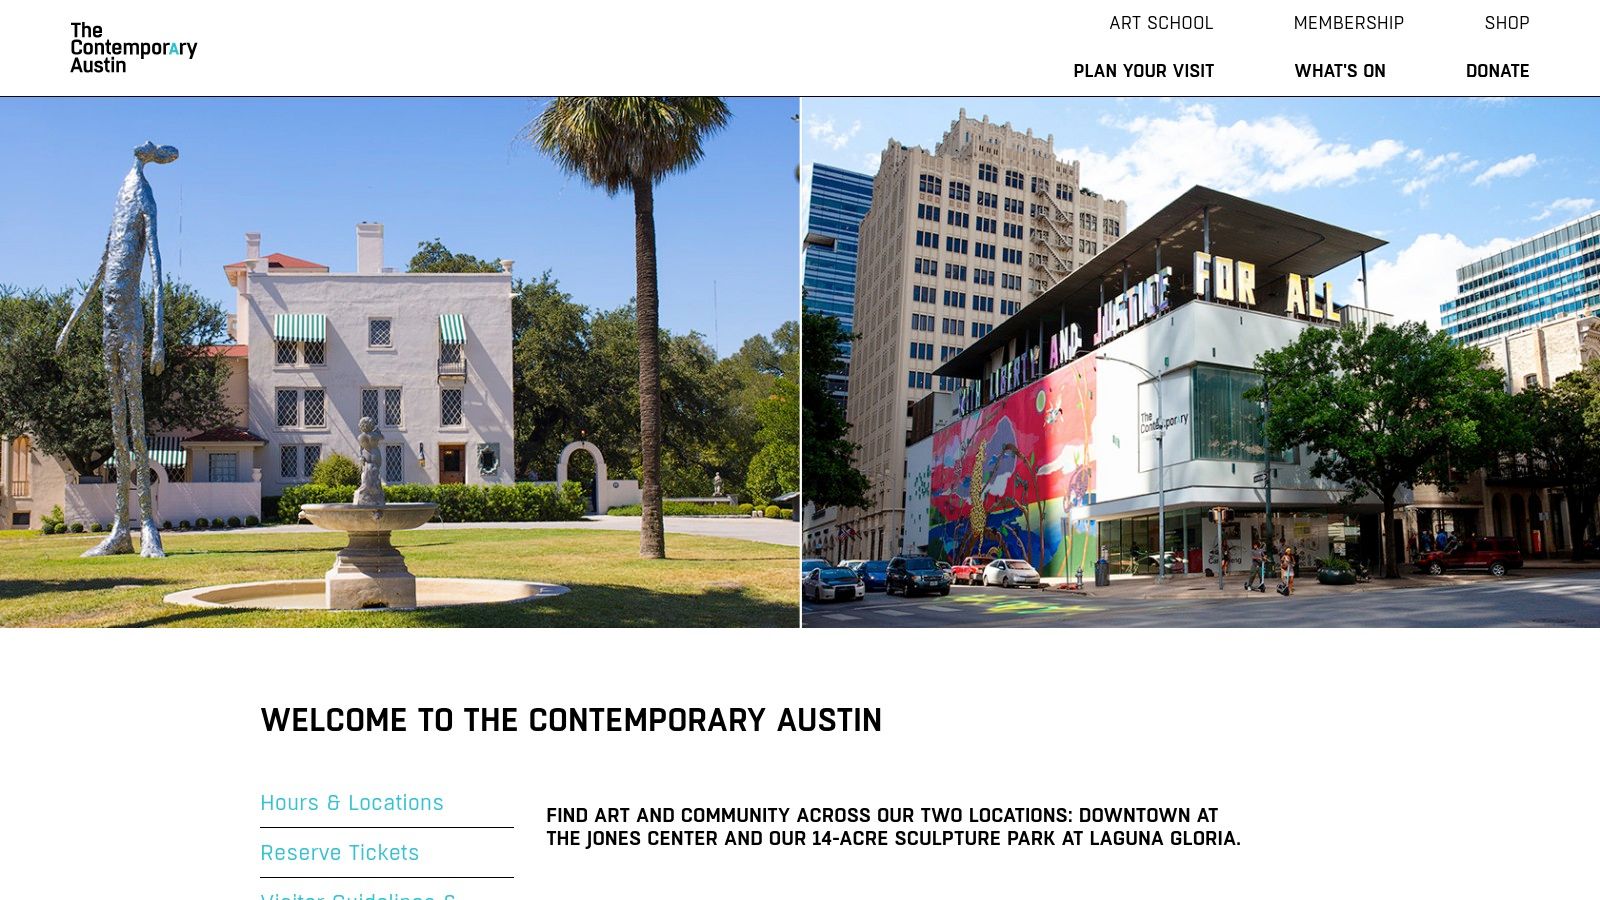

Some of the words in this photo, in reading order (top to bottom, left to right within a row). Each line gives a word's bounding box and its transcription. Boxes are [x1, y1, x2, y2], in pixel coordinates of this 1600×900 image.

[70, 22, 103, 38] The
[1110, 15, 1142, 30] ART
[1147, 15, 1214, 30] SCHOOL
[1294, 15, 1405, 30] MEMBERSHIP
[1484, 15, 1530, 30] SHOP
[70, 57, 127, 73] Austin
[1073, 63, 1117, 78] PLAN
[1123, 63, 1167, 78] YOUR
[1172, 63, 1215, 78] VISIT
[1294, 63, 1358, 78] WHAT'S
[1363, 63, 1386, 78] ON
[1466, 63, 1530, 78] DONATE
[989, 345, 1040, 401] LIBERTY
[1049, 322, 1082, 369] AND
[1093, 266, 1173, 346] JUSTICE
[1193, 251, 1257, 305] FOR
[1286, 272, 1341, 322] ALL
[1141, 411, 1153, 423] The
[260, 707, 407, 732] WELCOME
[417, 707, 453, 732] TO
[463, 707, 518, 732] THE
[529, 707, 767, 732] CONTEMPORARY
[776, 707, 882, 732] AUSTIN
[261, 794, 319, 811] Hours
[327, 794, 341, 811] &
[349, 793, 444, 811] Locations
[546, 807, 588, 823] FIND
[593, 807, 631, 823] ART
[635, 807, 675, 823] AND
[681, 807, 791, 823] COMMUNITY
[796, 807, 871, 823] ACROSS
[877, 807, 915, 823] OUR
[920, 807, 963, 823] TWO
[969, 807, 1073, 823] LOCATIONS:
[1079, 807, 1191, 823] DOWNTOWN
[1196, 807, 1219, 823] AT
[545, 830, 581, 846] THE
[584, 830, 641, 849] JONES
[647, 830, 718, 846] CENTER
[723, 830, 763, 846] AND
[768, 830, 807, 846] OUR
[812, 830, 889, 846] 14-ACRE
[894, 830, 1001, 846] SCULPTURE
[1007, 830, 1056, 846] PARK
[1061, 830, 1084, 846] AT
[1090, 830, 1165, 846] LAGUNA
[1170, 830, 1241, 846] GLORIA.
[261, 844, 341, 861] Reserve
[348, 843, 419, 861] Tickets
